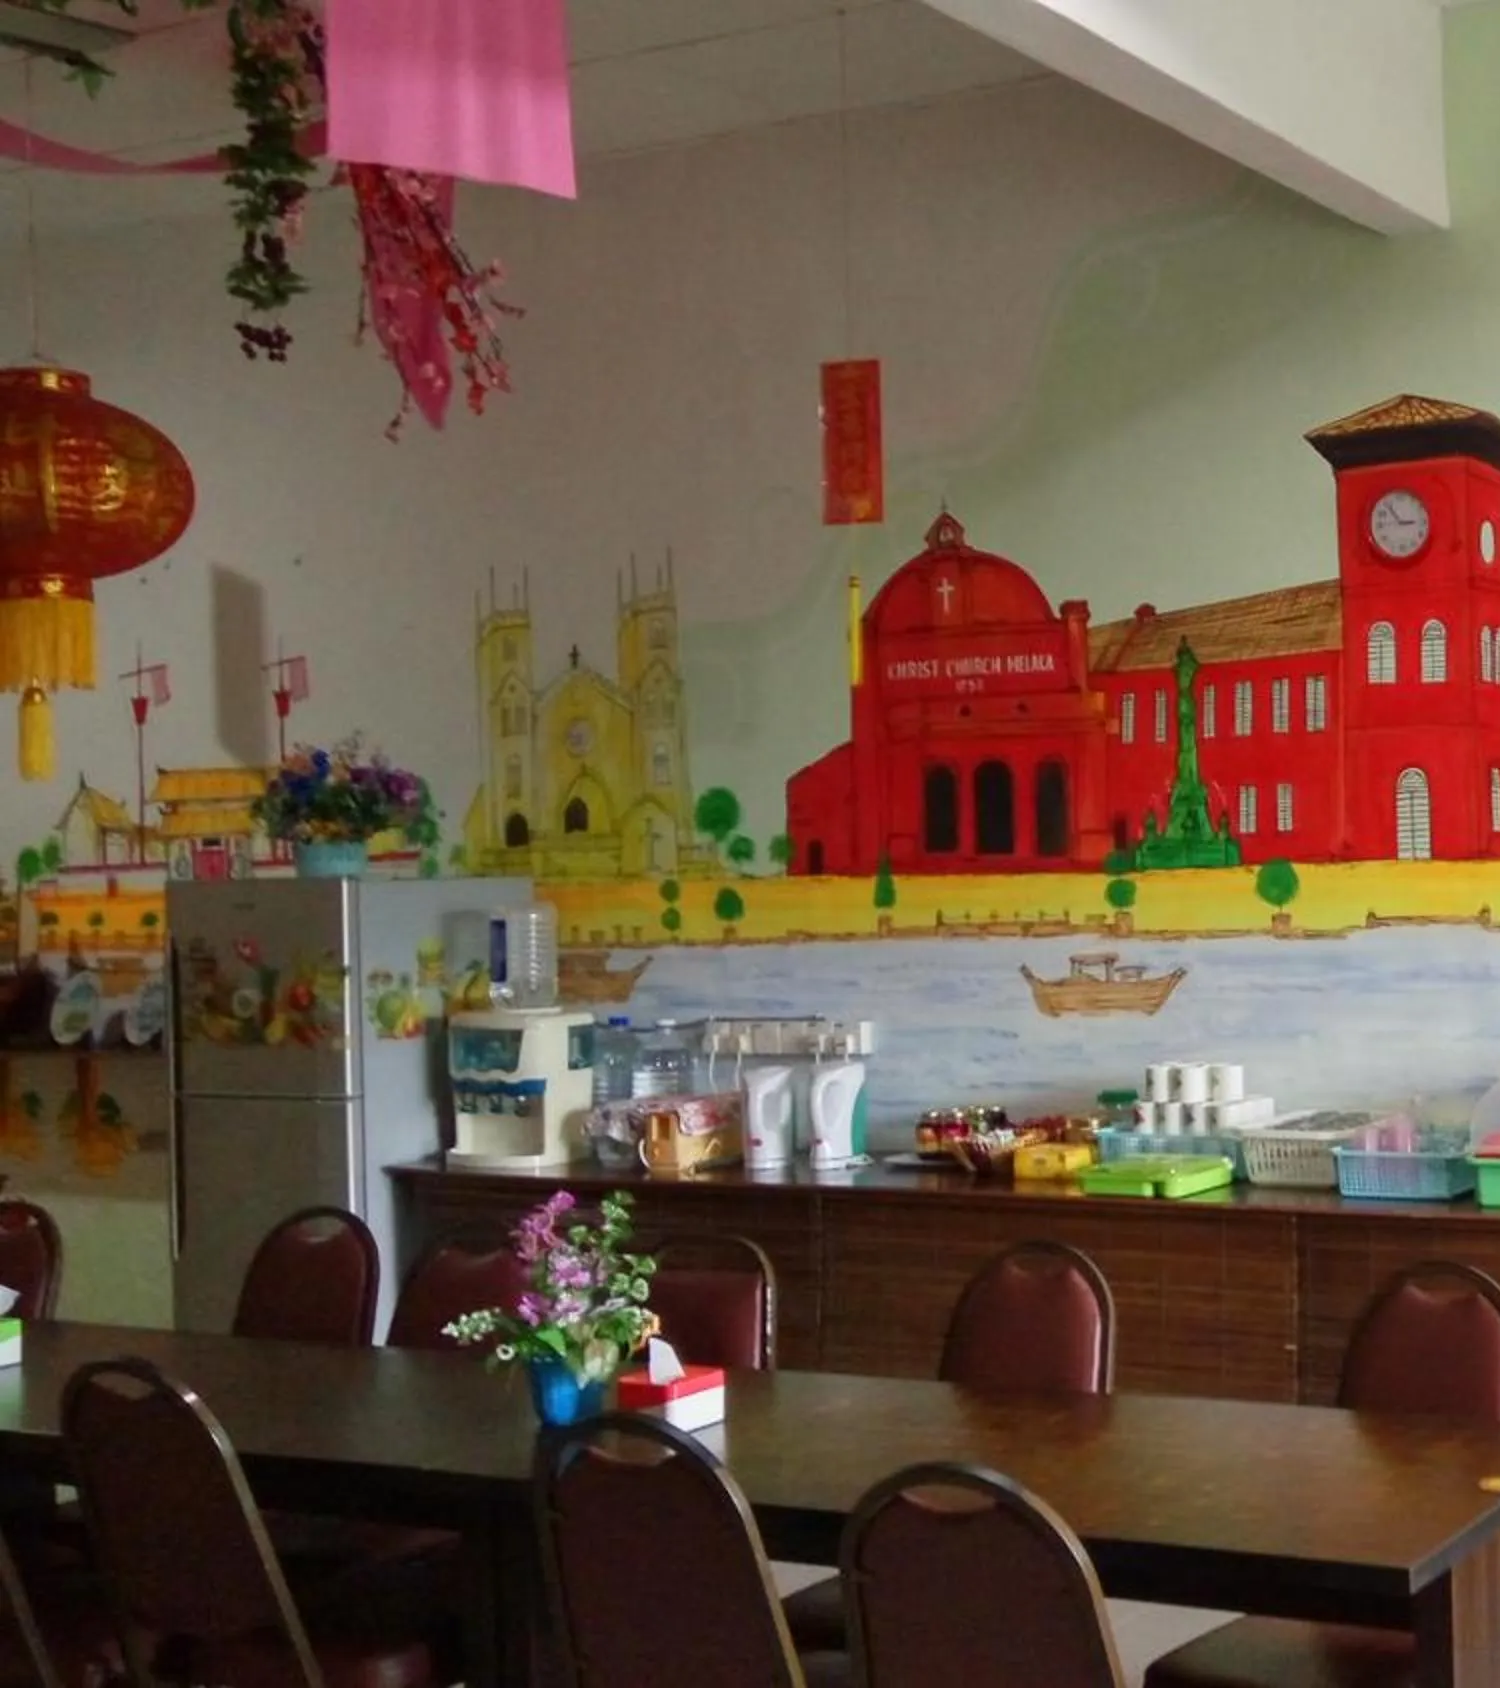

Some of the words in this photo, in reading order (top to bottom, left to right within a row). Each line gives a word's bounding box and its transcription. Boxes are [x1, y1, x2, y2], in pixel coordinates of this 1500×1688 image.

[887, 660, 939, 681] CHRIST
[946, 656, 1001, 679] CHURCH
[1007, 653, 1055, 674] MELAKA
